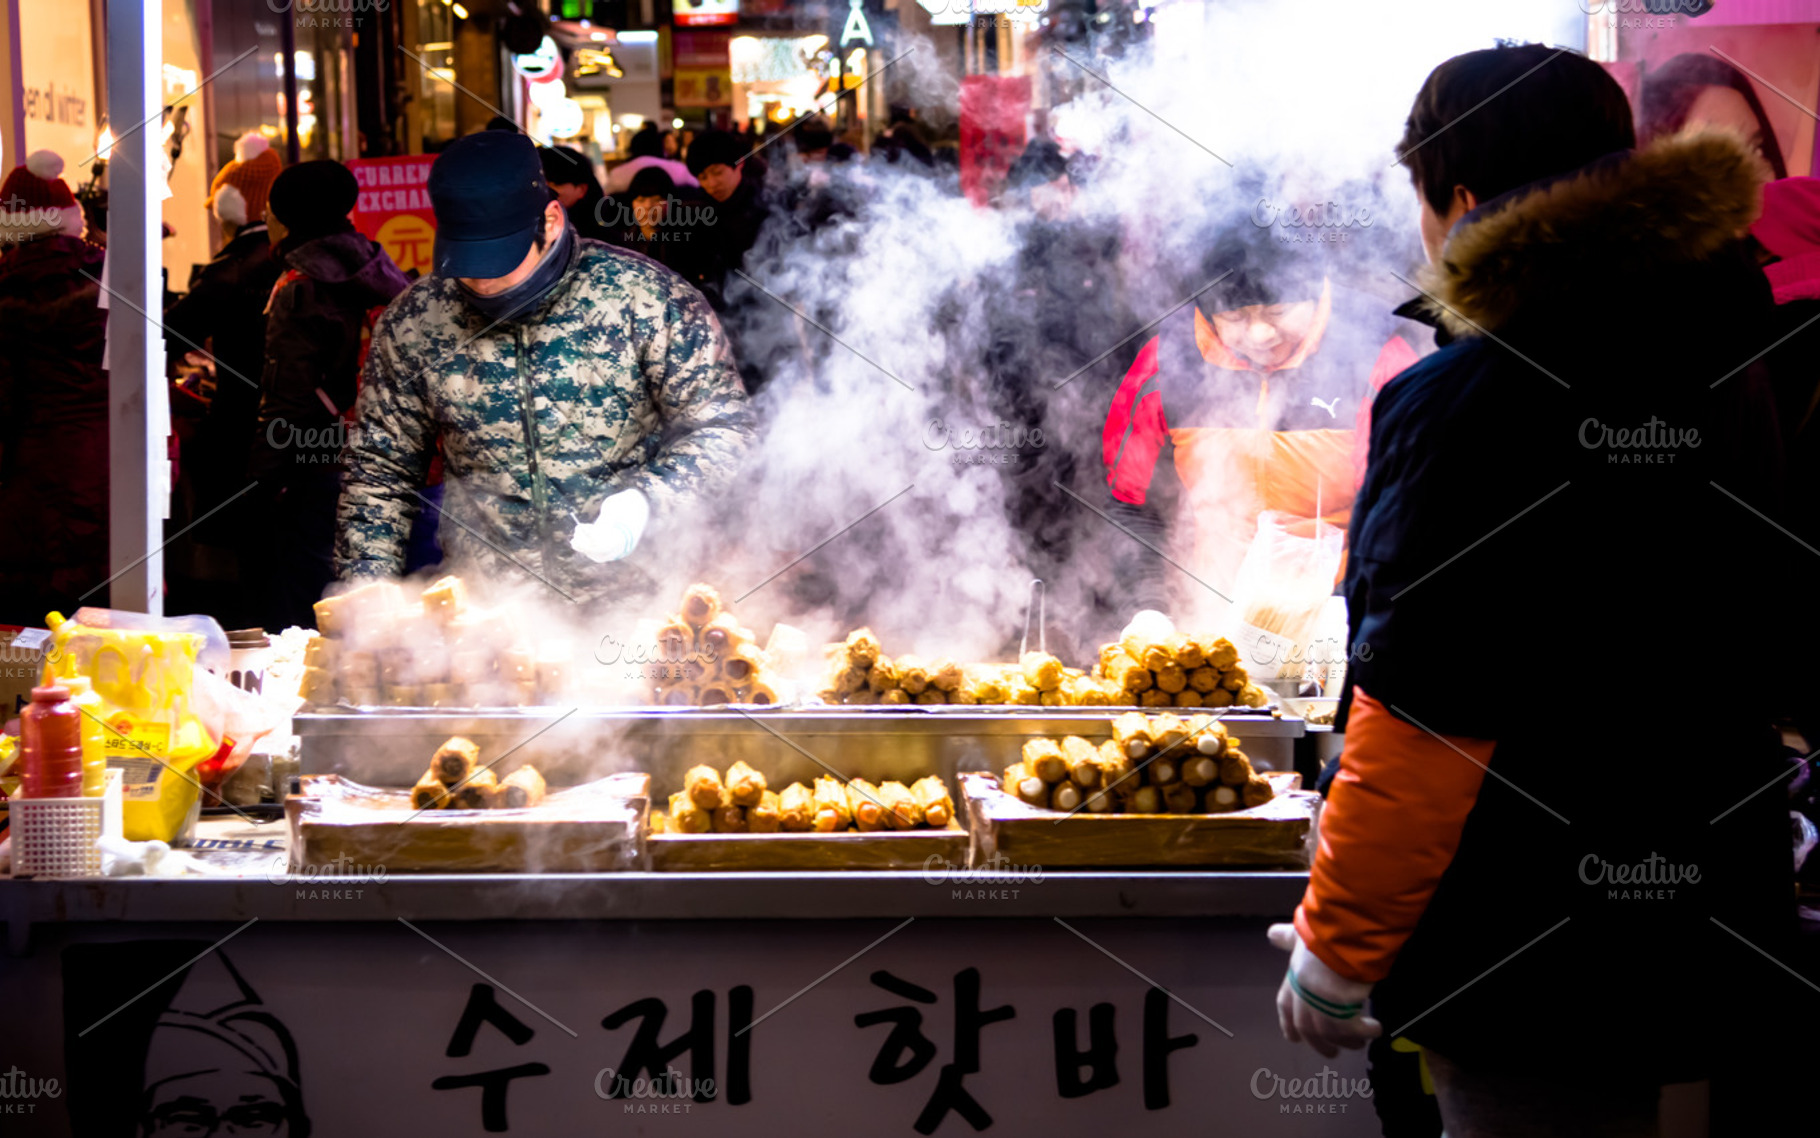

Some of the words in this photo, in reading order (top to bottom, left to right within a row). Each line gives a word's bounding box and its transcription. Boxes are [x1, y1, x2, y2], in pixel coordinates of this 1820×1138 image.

[388, 228, 431, 267] 元
[431, 983, 754, 1133] 수제
[854, 966, 1198, 1136] 핫바
